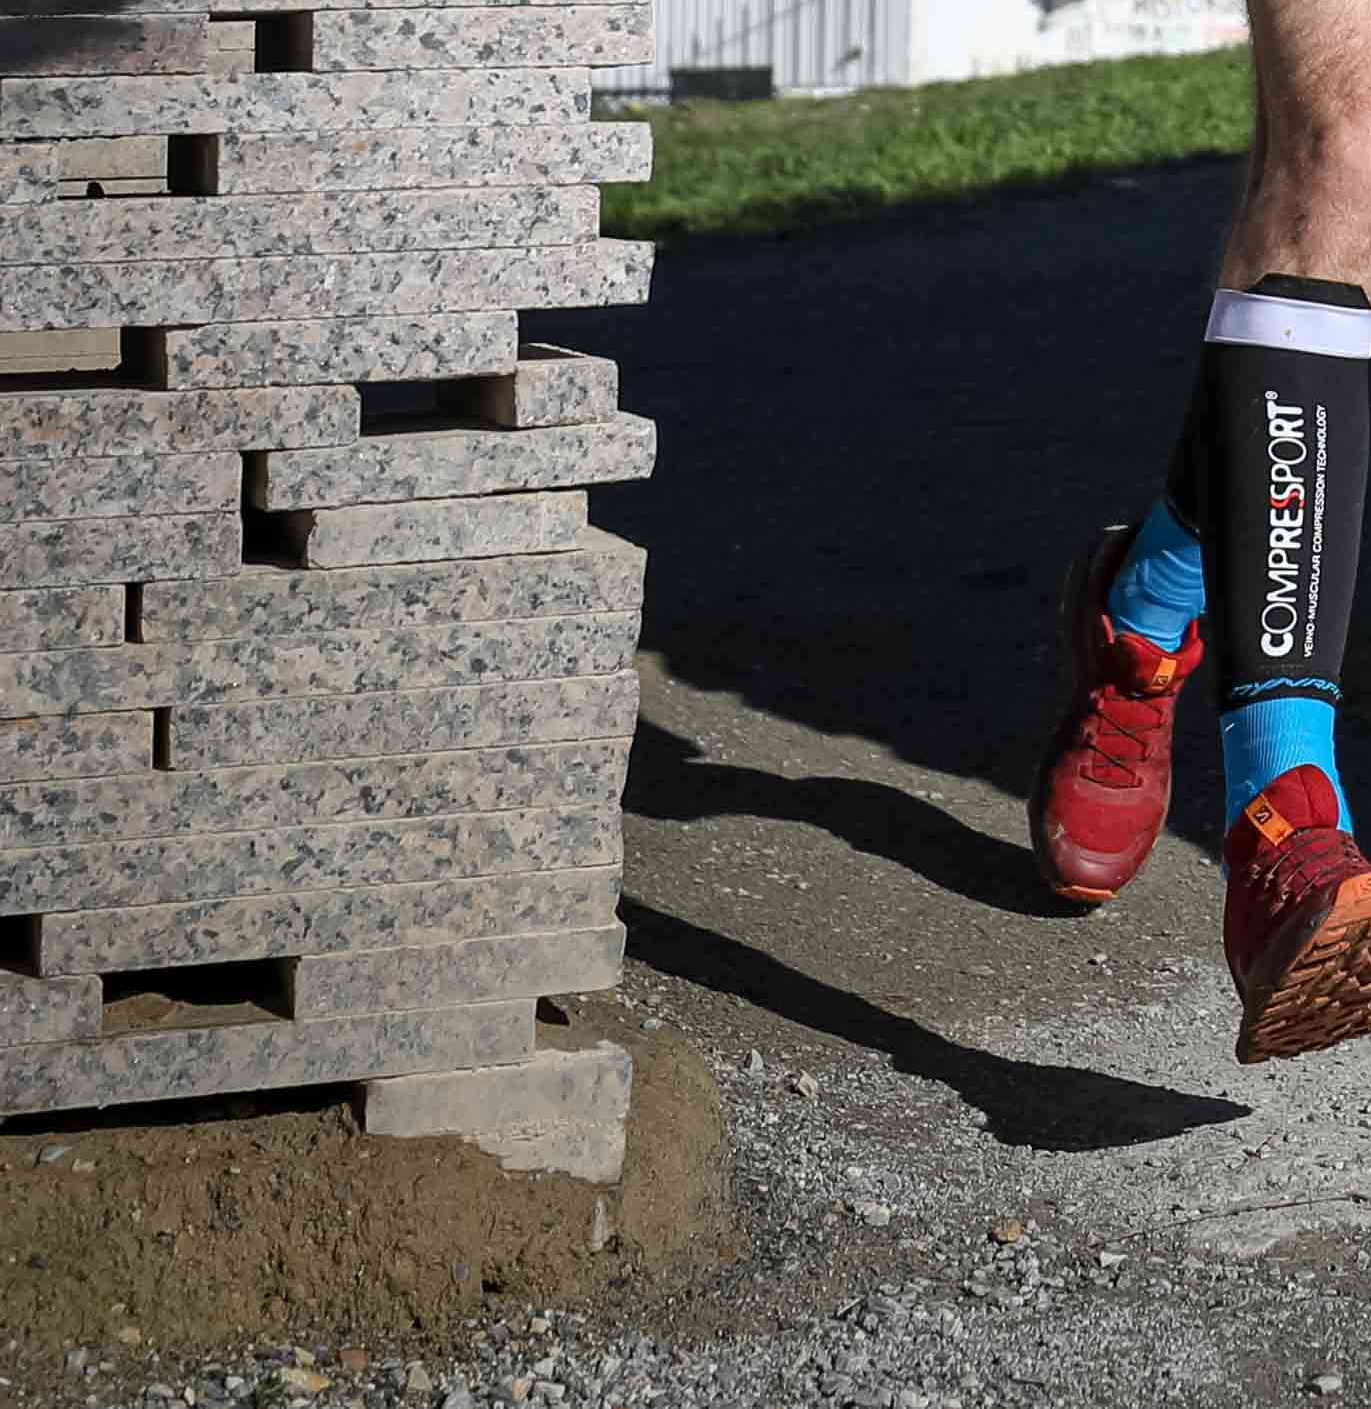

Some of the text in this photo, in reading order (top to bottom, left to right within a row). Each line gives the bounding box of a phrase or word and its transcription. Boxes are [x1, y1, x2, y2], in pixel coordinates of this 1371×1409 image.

[1303, 404, 1328, 658] VEINO-MUSCULAR COMPRESSION TECHNOLOGY
